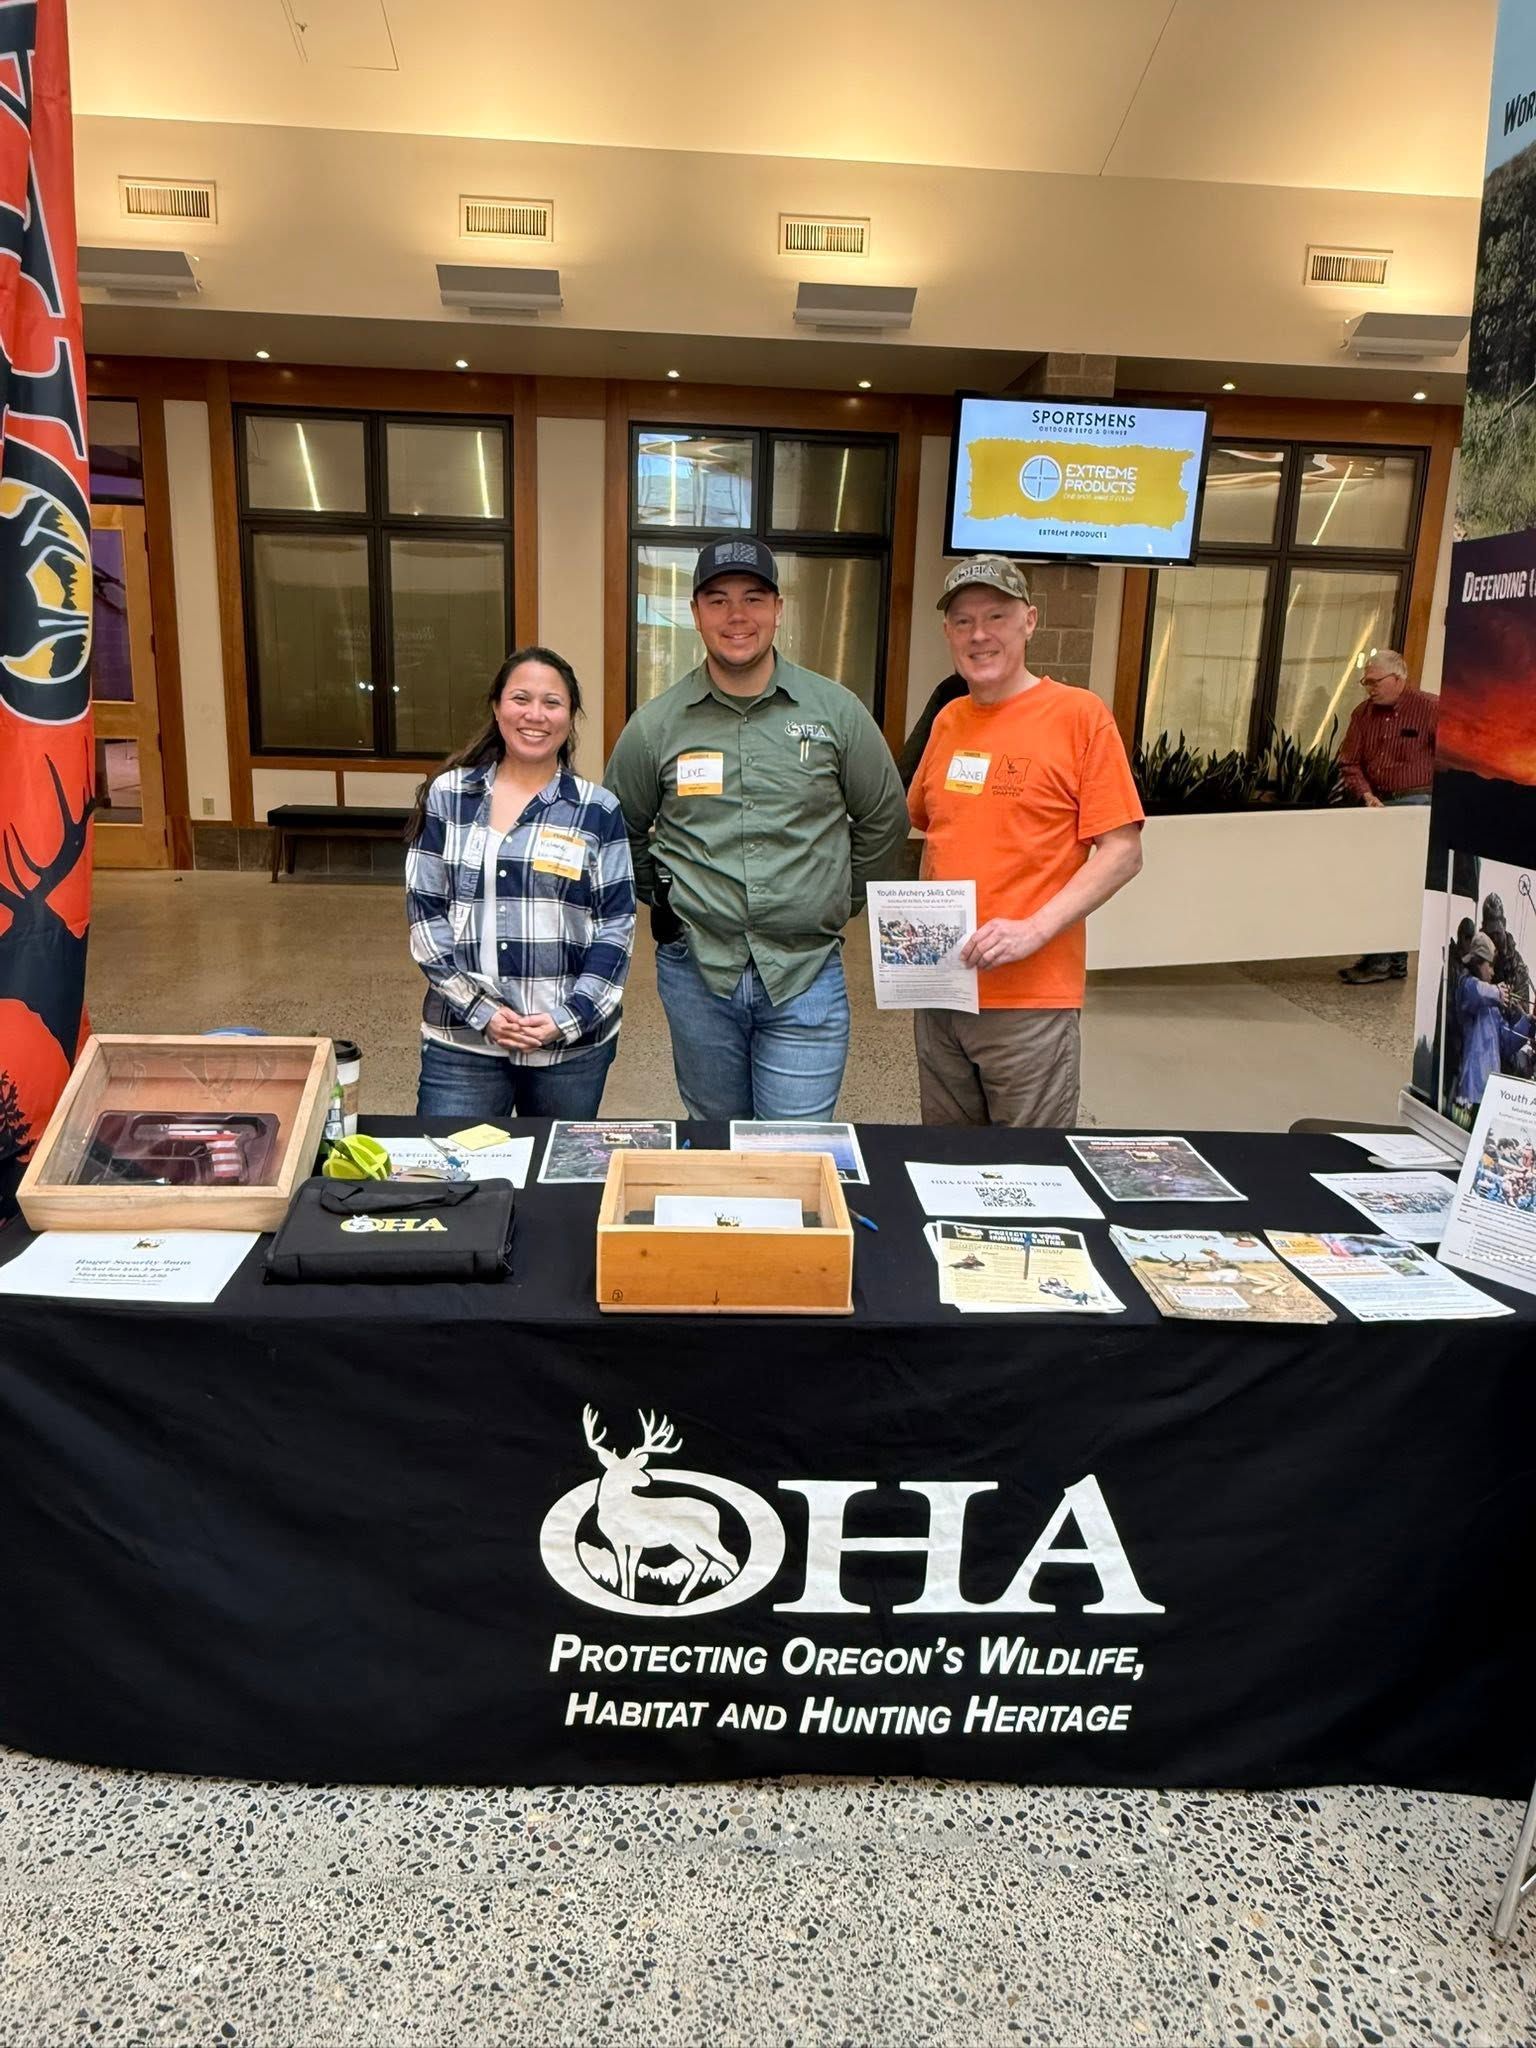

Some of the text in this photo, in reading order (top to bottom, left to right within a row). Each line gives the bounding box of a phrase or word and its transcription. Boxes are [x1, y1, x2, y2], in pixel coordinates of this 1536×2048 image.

[1503, 90, 1536, 137] WOR
[1032, 410, 1136, 428] SPORTSMENS
[1066, 463, 1138, 480] EXTREME
[1064, 480, 1136, 494] PRODUCTS
[1039, 529, 1068, 537] EXTREME
[1462, 571, 1527, 602] DEFENDING
[877, 888, 965, 898] Youth Archery Skills Clinic
[1500, 1089, 1529, 1105] Youth
[340, 1216, 448, 1233] OHA
[540, 1468, 1165, 1617] OHA
[550, 1633, 1145, 1681] PROTECTING OREGON'S WILDLIFE,
[565, 1692, 1133, 1736] HABITAT AND HUNTING HERITAGE
